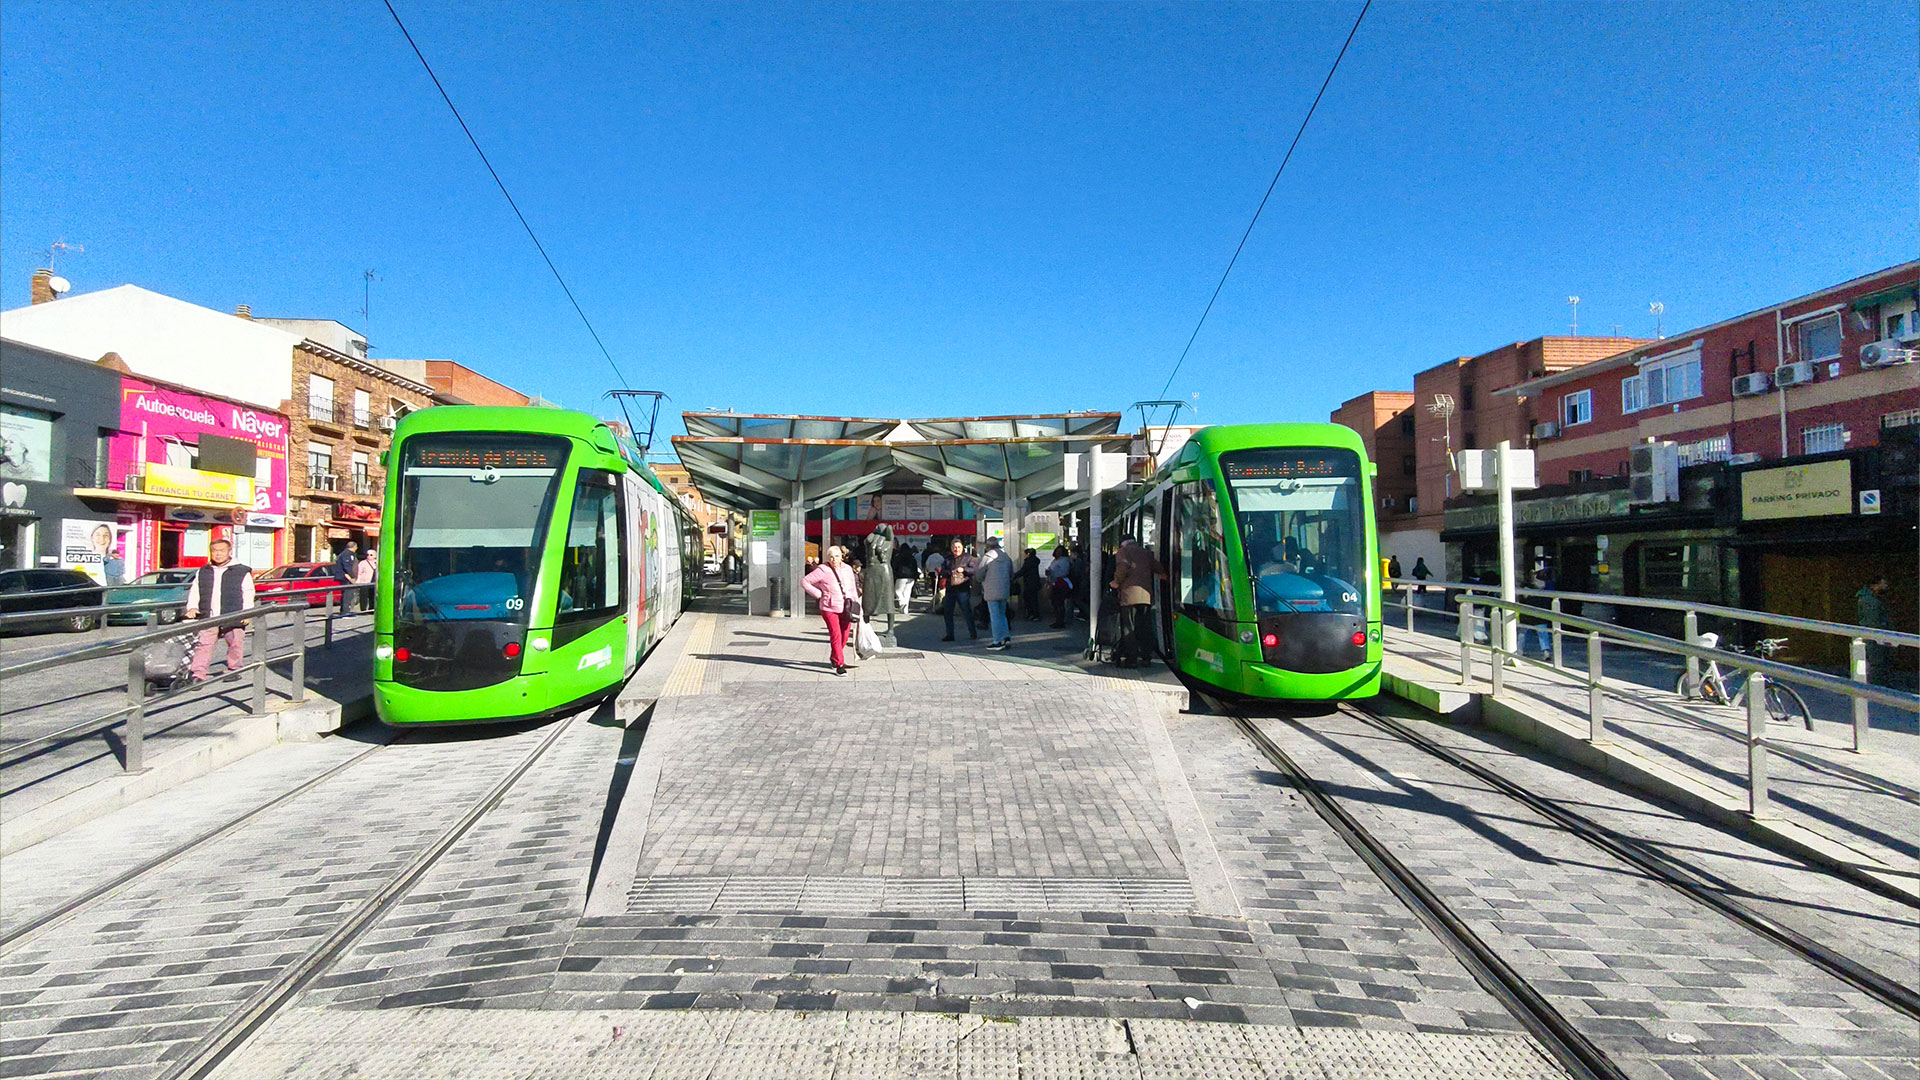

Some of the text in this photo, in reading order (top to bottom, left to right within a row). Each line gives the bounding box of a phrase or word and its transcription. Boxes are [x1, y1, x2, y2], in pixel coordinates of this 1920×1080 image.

[135, 394, 215, 425] Autoescuela
[232, 409, 283, 438] Nâyer
[151, 485, 190, 496] FINANCIA
[193, 490, 203, 498] TU
[1752, 489, 1840, 503] PARKING PRIVADO
[66, 553, 101, 563] GRATIS
[1342, 592, 1358, 603] 04
[505, 598, 524, 611] 09
